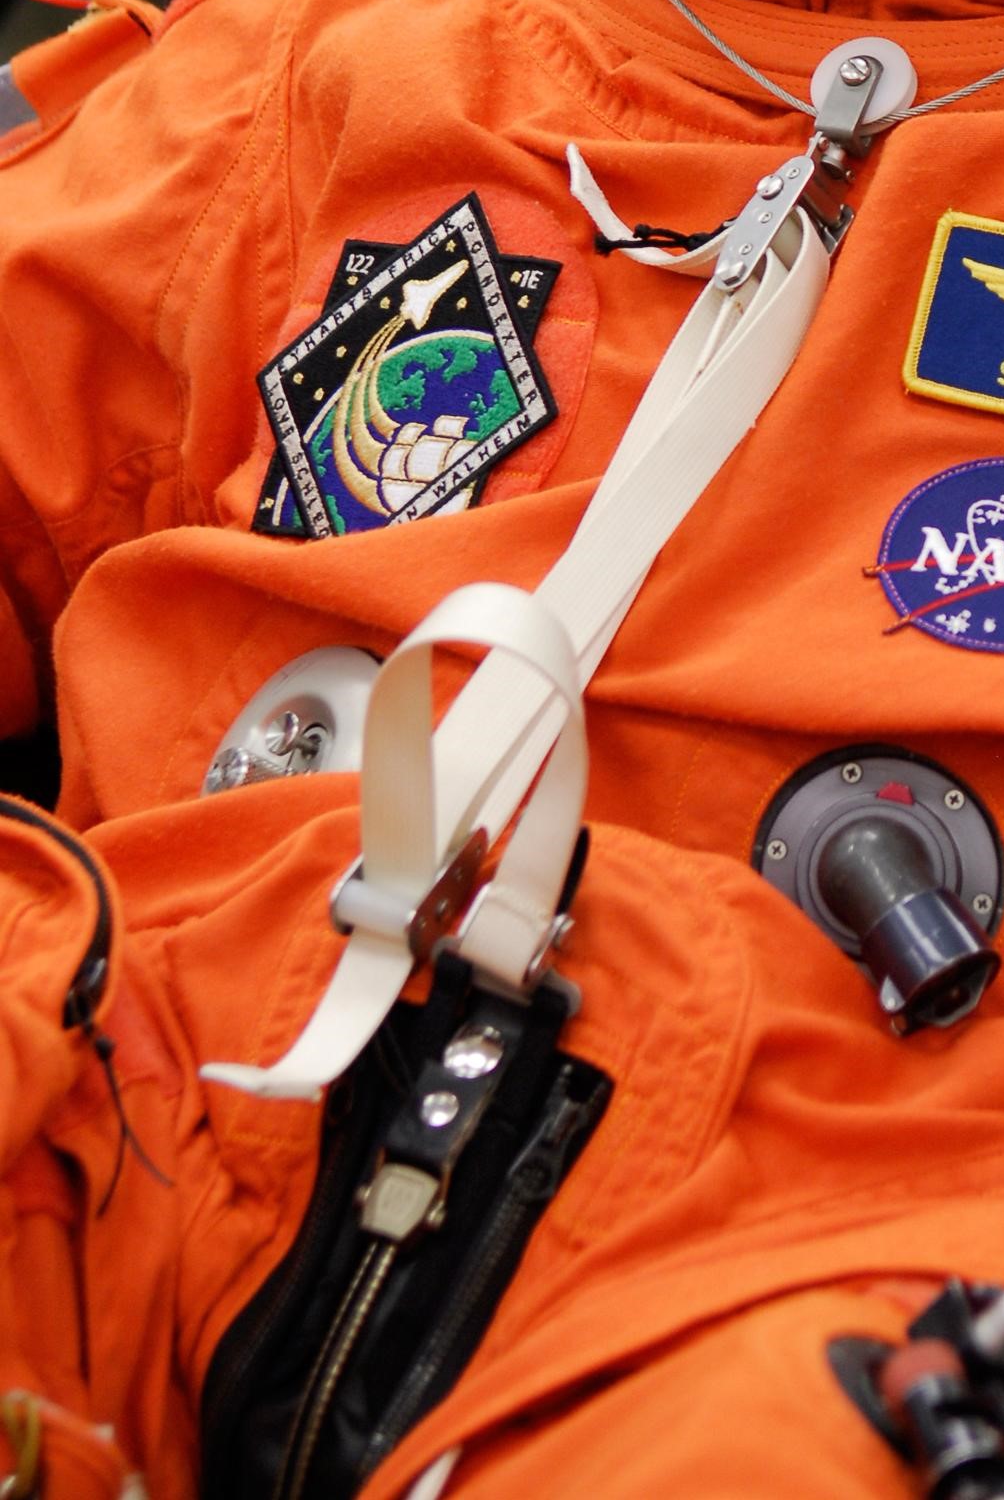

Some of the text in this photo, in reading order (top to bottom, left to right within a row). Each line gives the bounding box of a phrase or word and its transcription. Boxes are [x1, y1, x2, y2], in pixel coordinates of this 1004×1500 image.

[345, 253, 374, 275] 122
[388, 217, 455, 281] FRICK
[518, 269, 544, 290] 1E
[462, 221, 538, 405] POINDEXTER
[432, 413, 531, 498] WALHEIM
